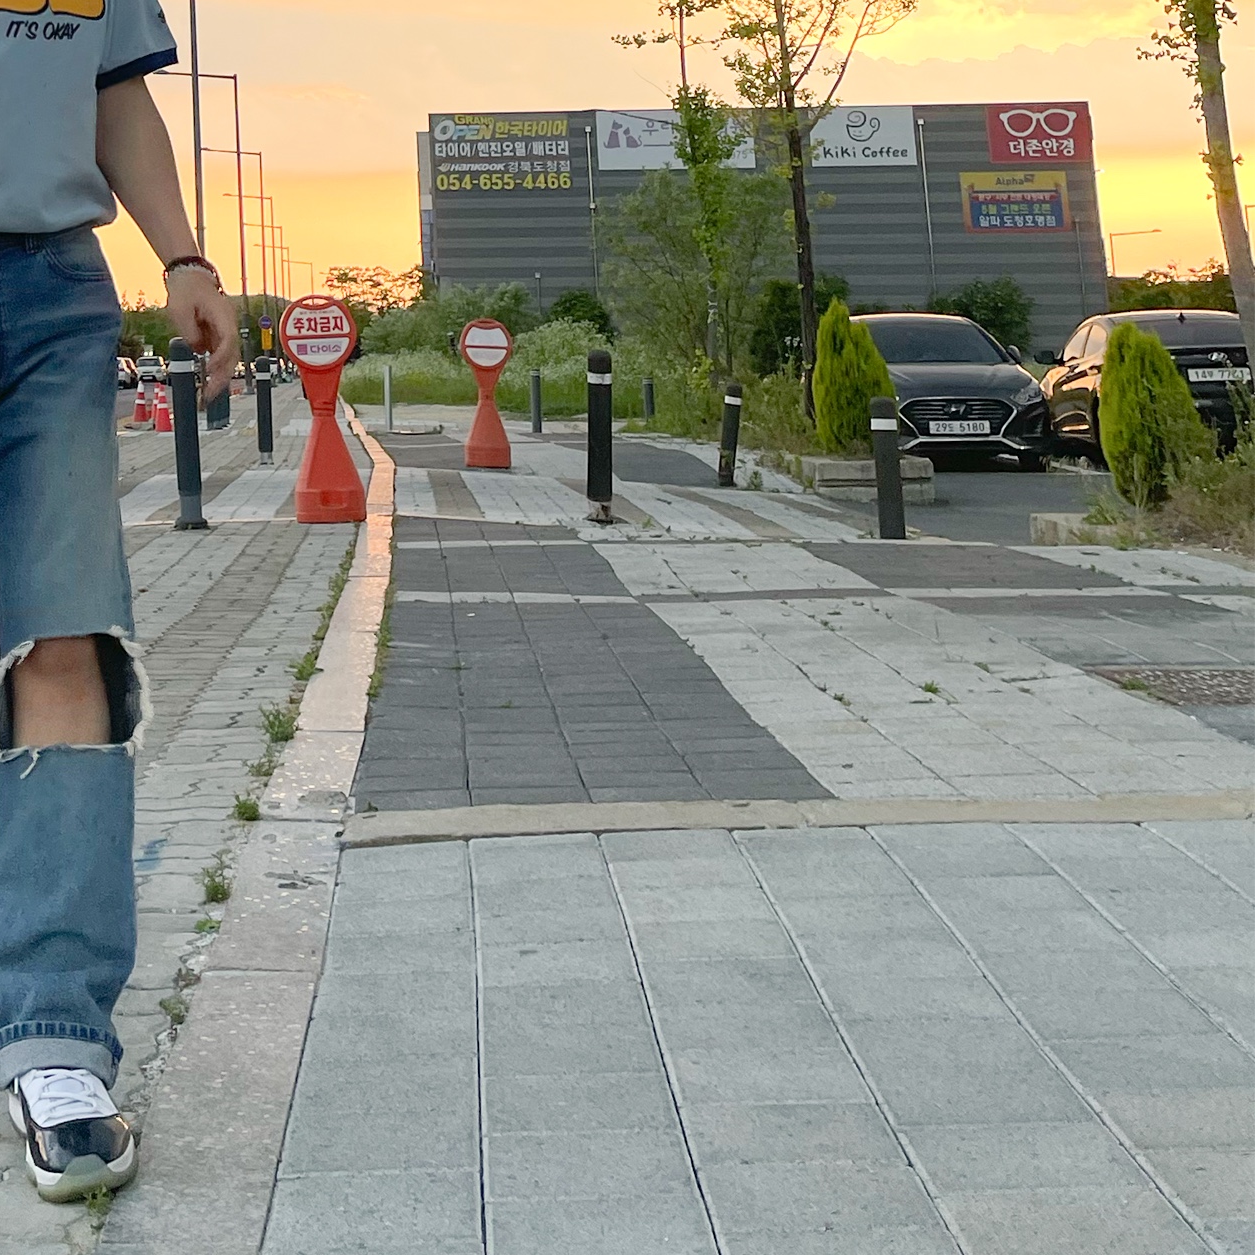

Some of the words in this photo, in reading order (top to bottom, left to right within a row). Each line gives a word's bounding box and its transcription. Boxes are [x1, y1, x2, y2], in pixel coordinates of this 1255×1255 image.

[6, 21, 38, 40] IT'S
[42, 22, 81, 40] OKAY
[454, 115, 494, 124] GRAND
[434, 119, 494, 140] OPEN
[495, 120, 568, 138] 한국타이어
[862, 146, 908, 158] Coffee
[1008, 138, 1075, 157] 더존안경
[436, 173, 572, 191] 054-655-4466
[995, 177, 1025, 186] Alpha
[979, 216, 1000, 227] 알파
[293, 316, 344, 334] 주차금지
[310, 344, 342, 353] 다이소
[959, 422, 985, 432] 5180
